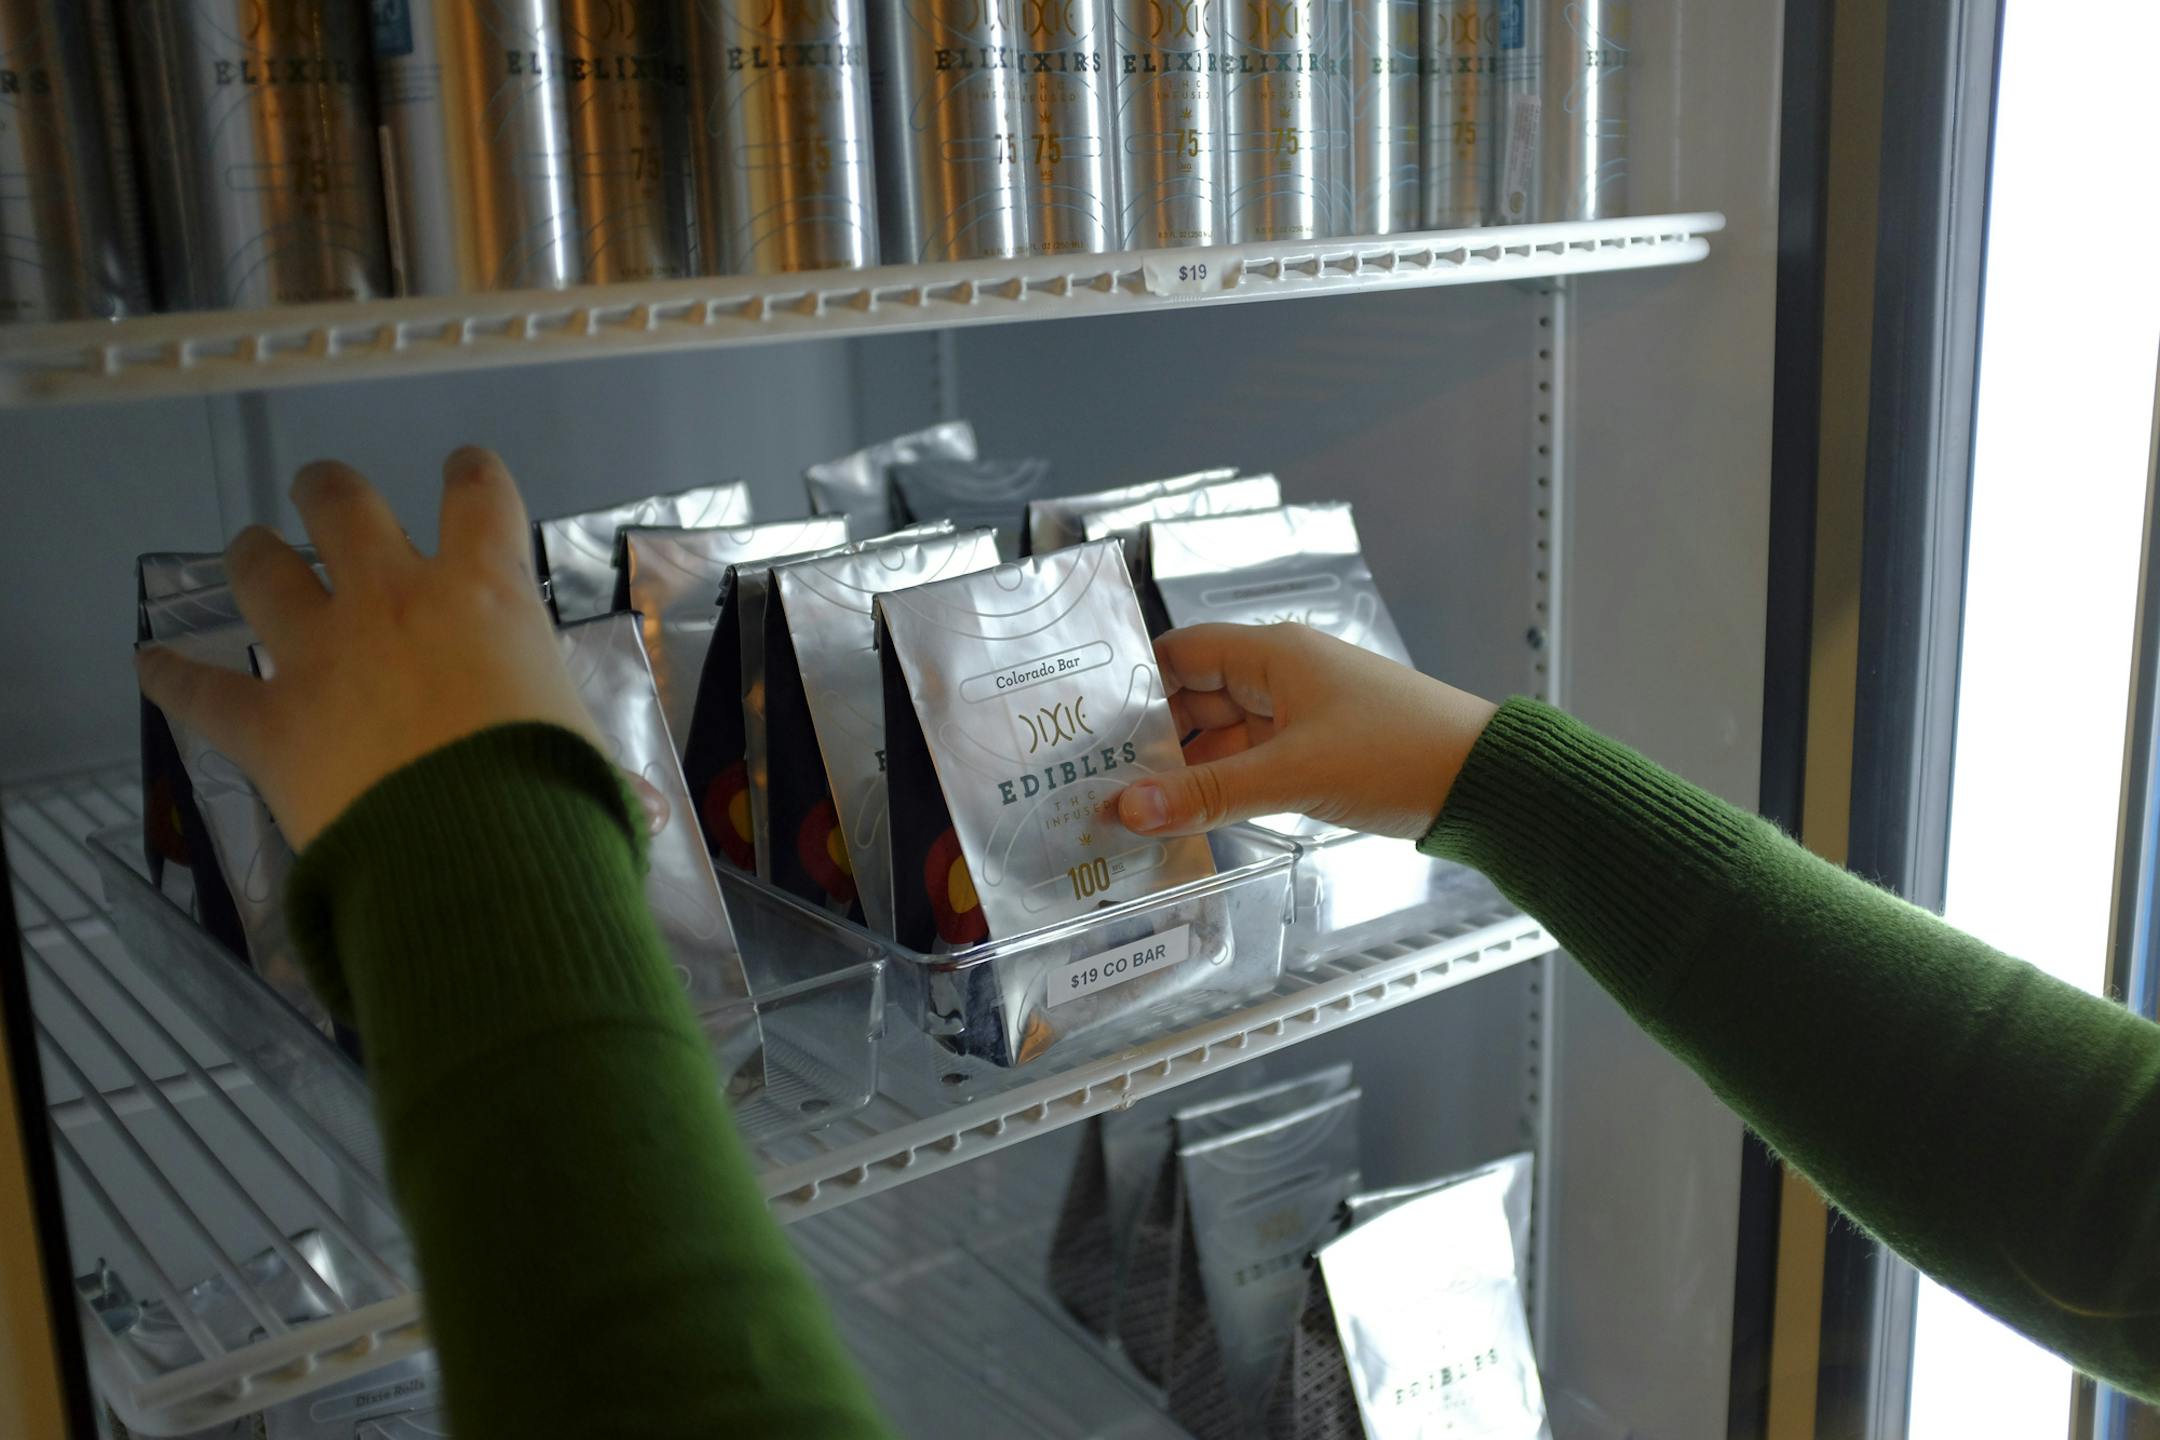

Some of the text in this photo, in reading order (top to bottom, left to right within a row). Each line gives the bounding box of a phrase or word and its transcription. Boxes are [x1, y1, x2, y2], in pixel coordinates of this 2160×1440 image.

[1123, 52, 1218, 74] ELIXIR
[1221, 52, 1319, 75] ELIXIR
[1031, 133, 1062, 165] 75
[1175, 127, 1199, 160] 75
[1272, 127, 1299, 159] 75
[1178, 263, 1207, 281] $19
[996, 656, 1081, 689] Colorado Bar
[1018, 695, 1094, 754] DIXIE
[998, 741, 1137, 806] EDIBLES
[1066, 856, 1111, 901] 100
[1070, 944, 1166, 989] $19 CO BAR
